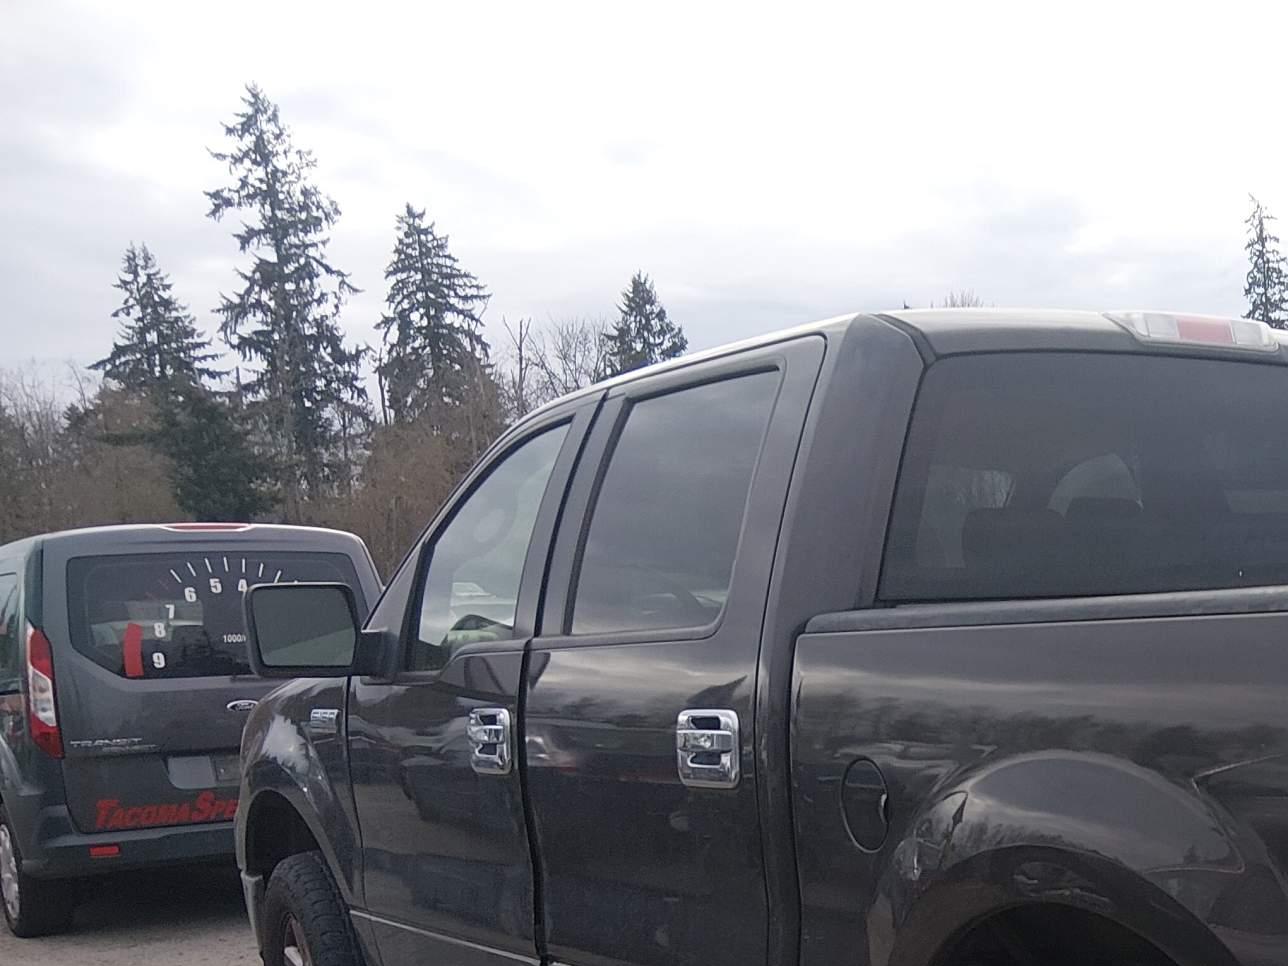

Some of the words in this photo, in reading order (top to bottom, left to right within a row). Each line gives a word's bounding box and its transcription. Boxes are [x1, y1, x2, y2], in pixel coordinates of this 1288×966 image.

[209, 578, 222, 593] 5
[238, 579, 248, 593] 4
[184, 587, 197, 602] 6
[165, 604, 175, 619] 7
[153, 622, 166, 638] 8
[152, 652, 166, 668] 9
